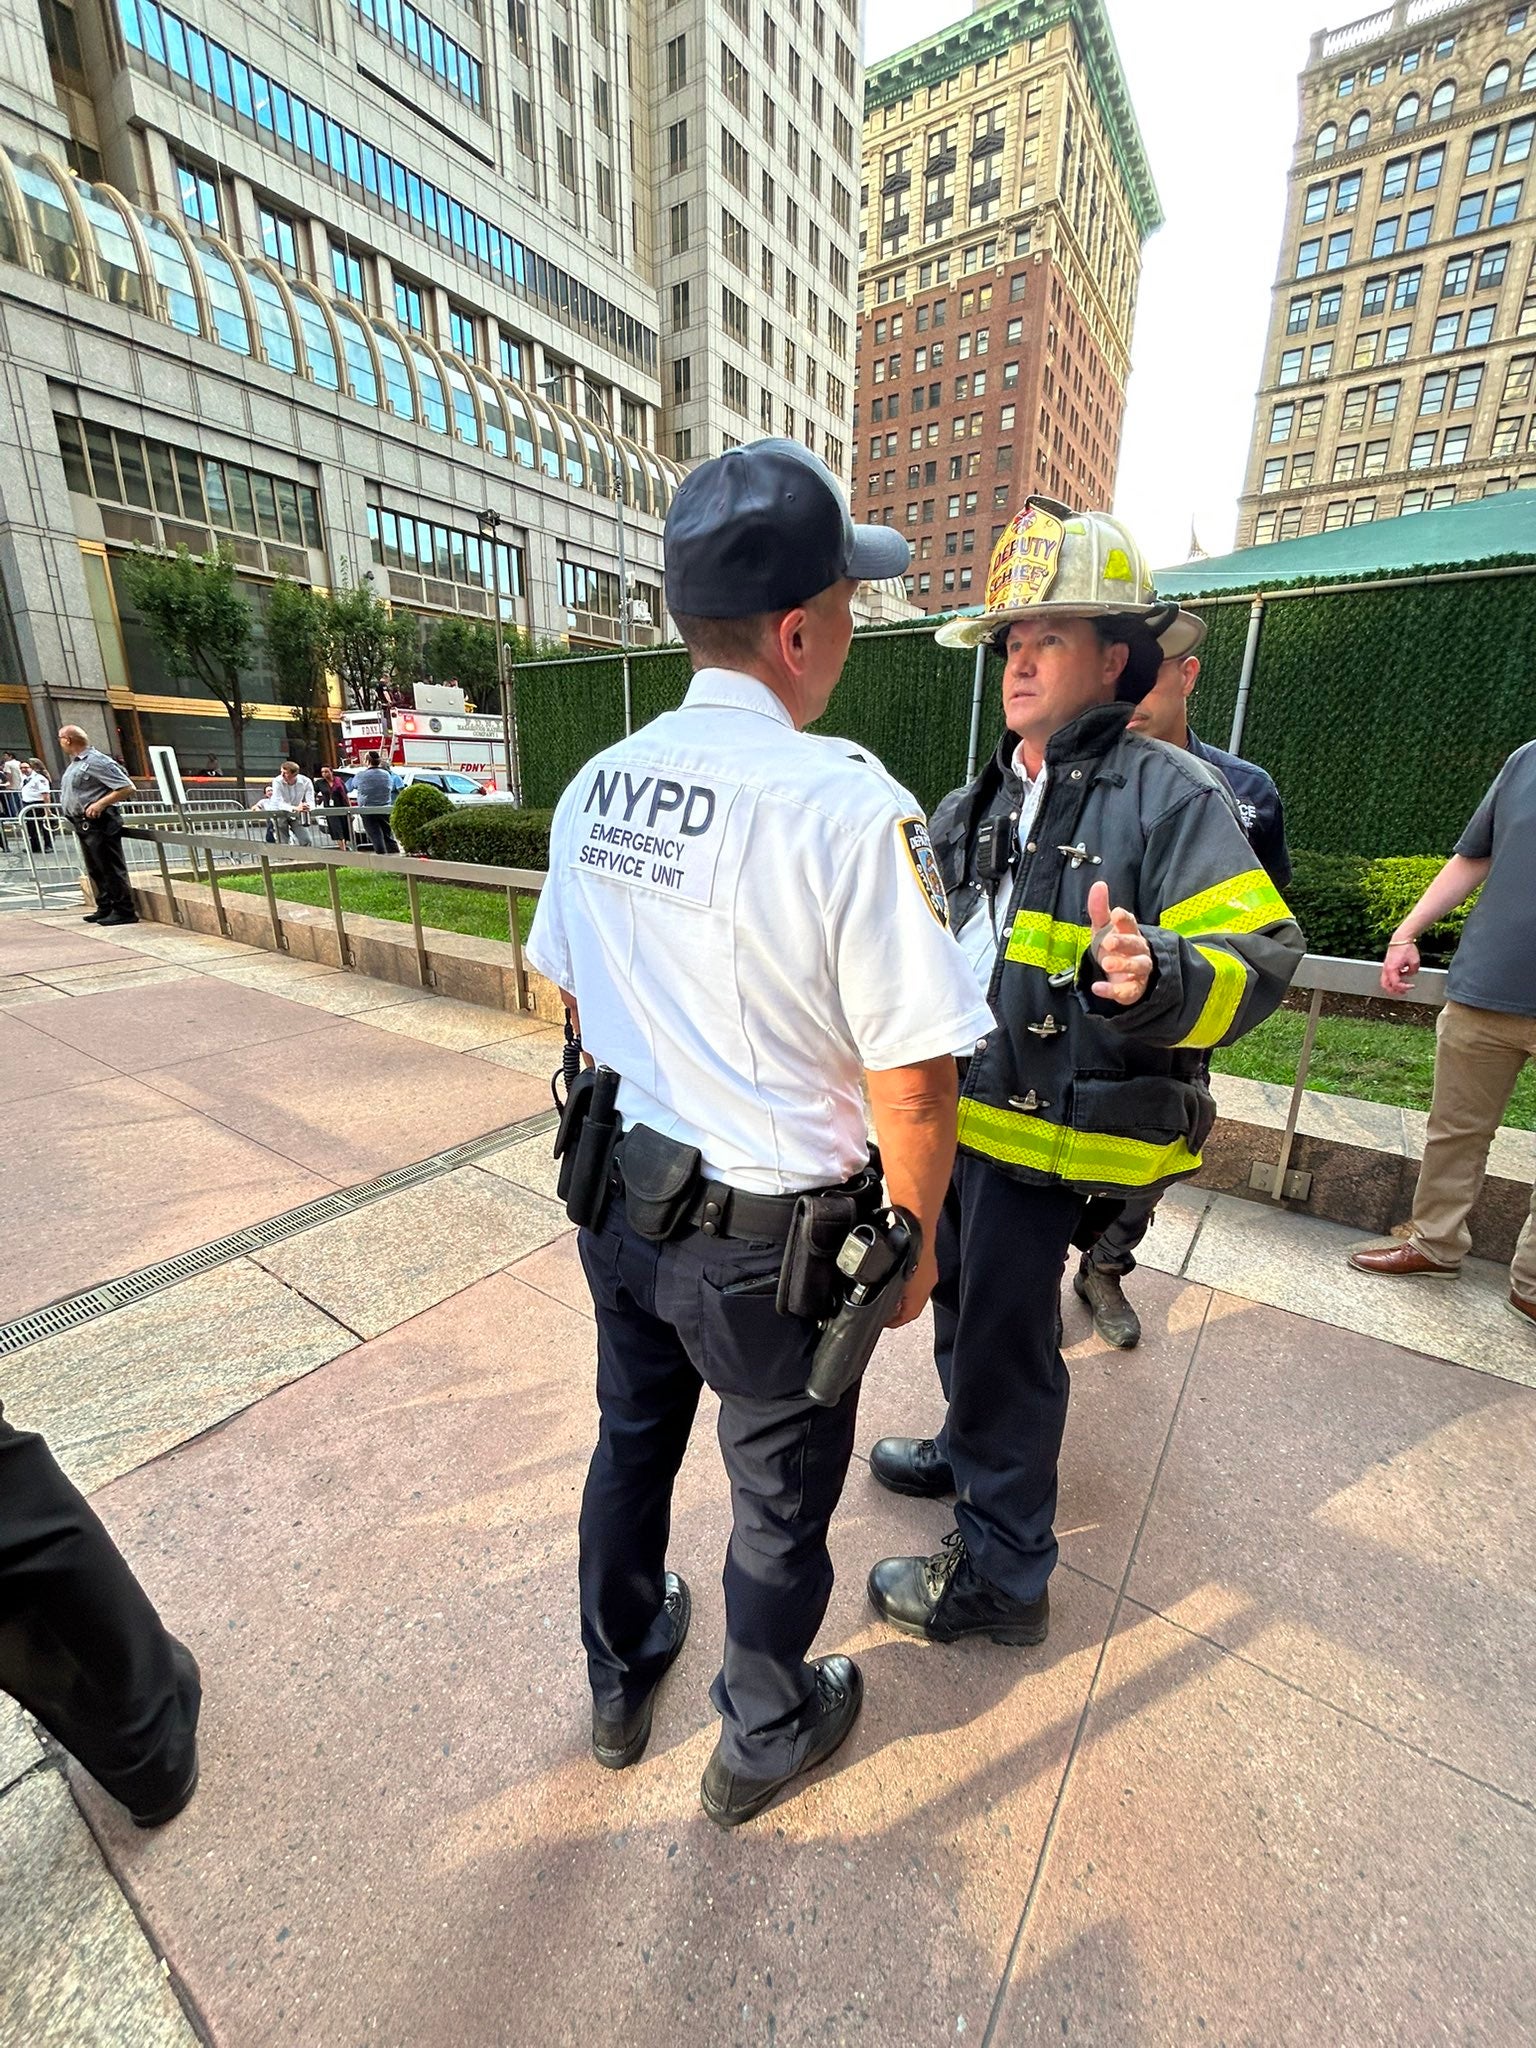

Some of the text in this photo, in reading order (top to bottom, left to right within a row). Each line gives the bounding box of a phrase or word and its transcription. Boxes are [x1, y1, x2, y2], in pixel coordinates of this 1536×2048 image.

[993, 536, 1057, 574] DEPUTY
[990, 563, 1045, 593] CHIEF
[362, 725, 379, 736] FDNY
[460, 763, 486, 773] FDNY
[583, 769, 716, 837] NYPD
[589, 823, 685, 862] EMERGENCY
[579, 845, 685, 890] SERVICE UNIT
